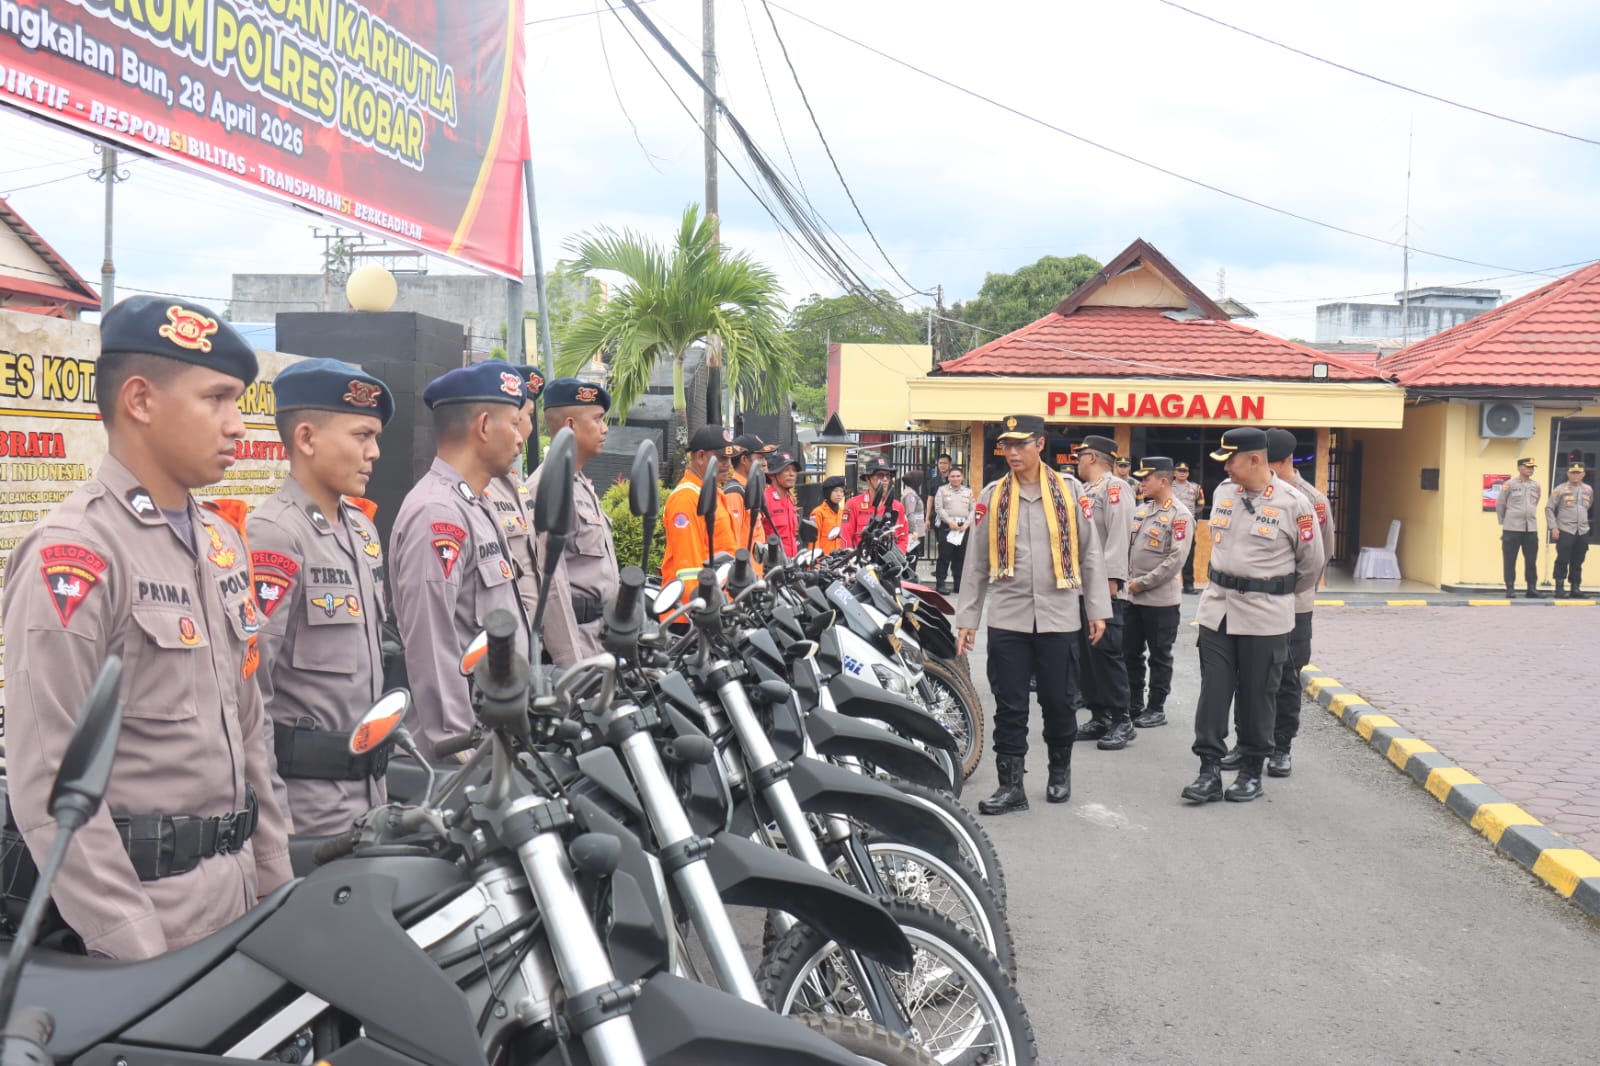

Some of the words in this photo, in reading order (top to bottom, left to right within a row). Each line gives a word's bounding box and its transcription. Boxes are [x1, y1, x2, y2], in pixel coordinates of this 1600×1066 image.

[337, 4, 455, 118] KARHUTLA
[215, 6, 336, 118] POLRES
[341, 78, 422, 162] KOBAR
[121, 48, 174, 107] Bun,
[179, 75, 206, 113] 28
[210, 91, 257, 136] April
[261, 113, 304, 157] 2026
[89, 99, 246, 175] RESPONSIBILITAS
[258, 163, 352, 214] TRANSPARANSI
[354, 201, 423, 241] BERKEADILAN
[42, 354, 97, 403] KOT
[1048, 391, 1264, 420] PENJAGAAN
[1216, 507, 1233, 516] THEO
[1256, 515, 1280, 526] POLRI
[44, 546, 103, 572] PELOPOR
[253, 552, 297, 573] PELOPOR
[310, 566, 353, 585] TIRTA
[138, 580, 191, 606] PRIMA
